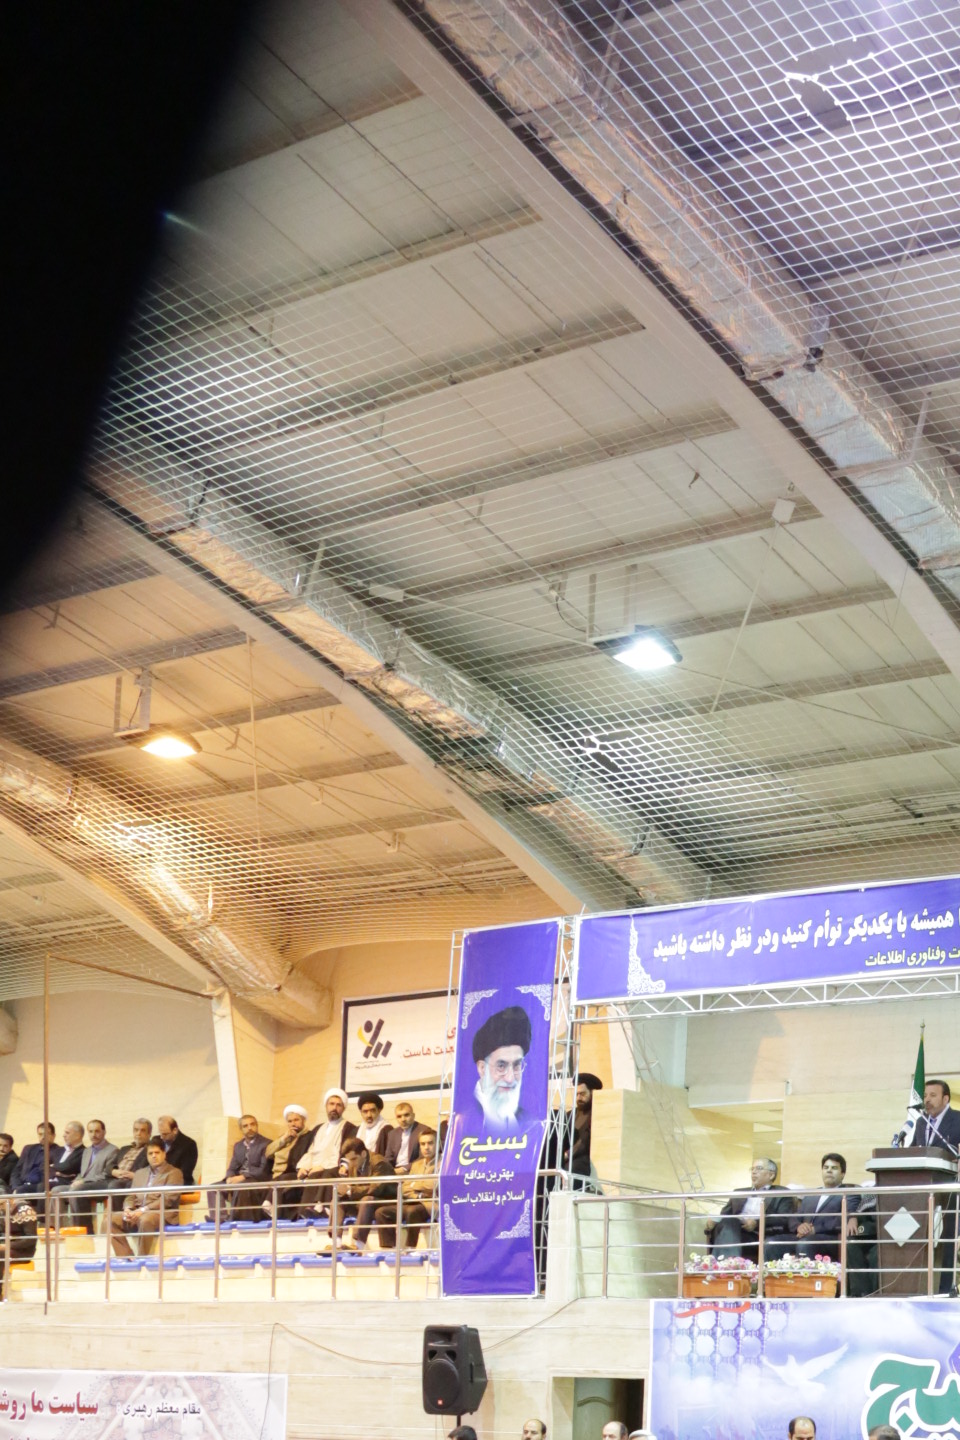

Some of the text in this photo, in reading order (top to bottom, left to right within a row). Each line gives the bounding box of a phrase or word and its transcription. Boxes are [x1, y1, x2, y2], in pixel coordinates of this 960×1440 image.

[781, 919, 812, 948] کنید
[844, 912, 893, 945] یکدیگر
[896, 910, 907, 938] با
[910, 908, 954, 936] همیشه
[653, 932, 687, 962] باشید
[689, 929, 725, 953] داشته
[726, 925, 752, 957] نظر
[865, 950, 906, 966] اطلاعات
[459, 1134, 528, 1165] بسیج
[464, 1168, 515, 1185] بهترین مدافع
[452, 1192, 469, 1204] است
[501, 1190, 525, 1206] اسلام
[0, 1390, 99, 1421] سیاست ما روش
